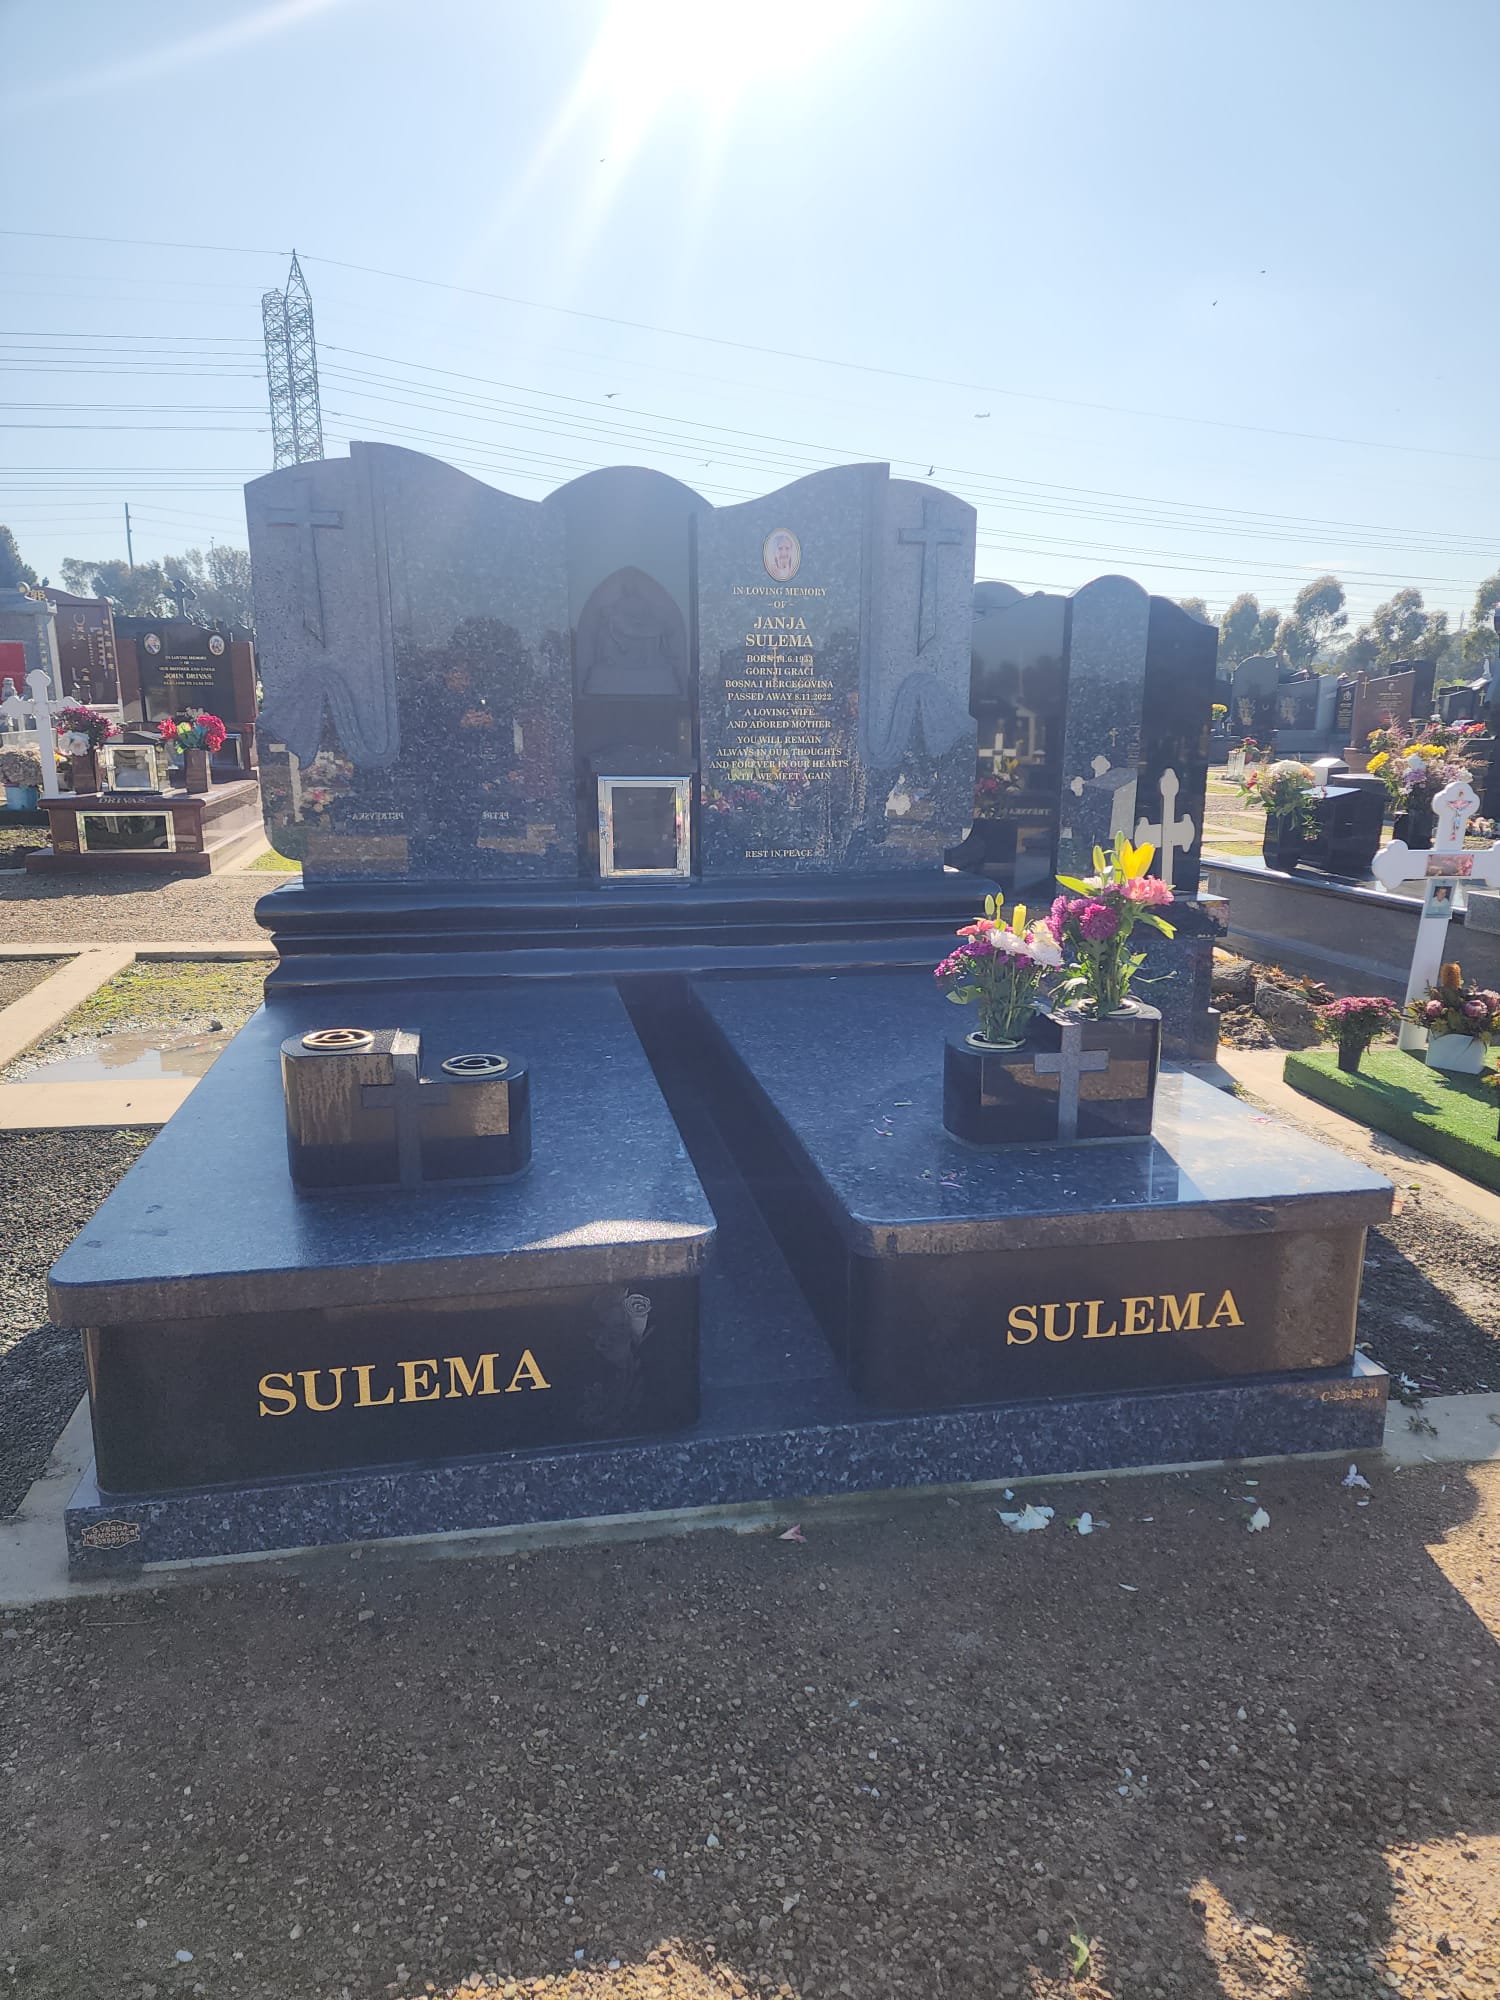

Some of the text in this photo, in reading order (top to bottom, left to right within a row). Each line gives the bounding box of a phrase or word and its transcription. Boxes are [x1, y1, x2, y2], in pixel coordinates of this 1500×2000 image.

[733, 586, 828, 596] IN LOVING MEMORY
[754, 616, 806, 629] JANJA
[745, 634, 813, 647] SULEMA
[746, 655, 773, 663] BORN
[745, 667, 782, 676] GORNJI
[725, 680, 757, 688] BOSNA
[765, 680, 834, 688] HERCEGOVINA
[727, 693, 764, 701] PASSED
[791, 708, 815, 716] WIFE
[737, 736, 758, 744] YOU
[759, 736, 782, 744] WILL
[709, 761, 729, 769] AND
[732, 761, 776, 769] FOREVER
[812, 760, 849, 768] HEARTS
[802, 772, 832, 780] AGAIN
[745, 850, 768, 858] REST
[783, 849, 813, 857] PEACE
[1006, 1289, 1245, 1346] SULEMA
[257, 1348, 552, 1417] SULEMA
